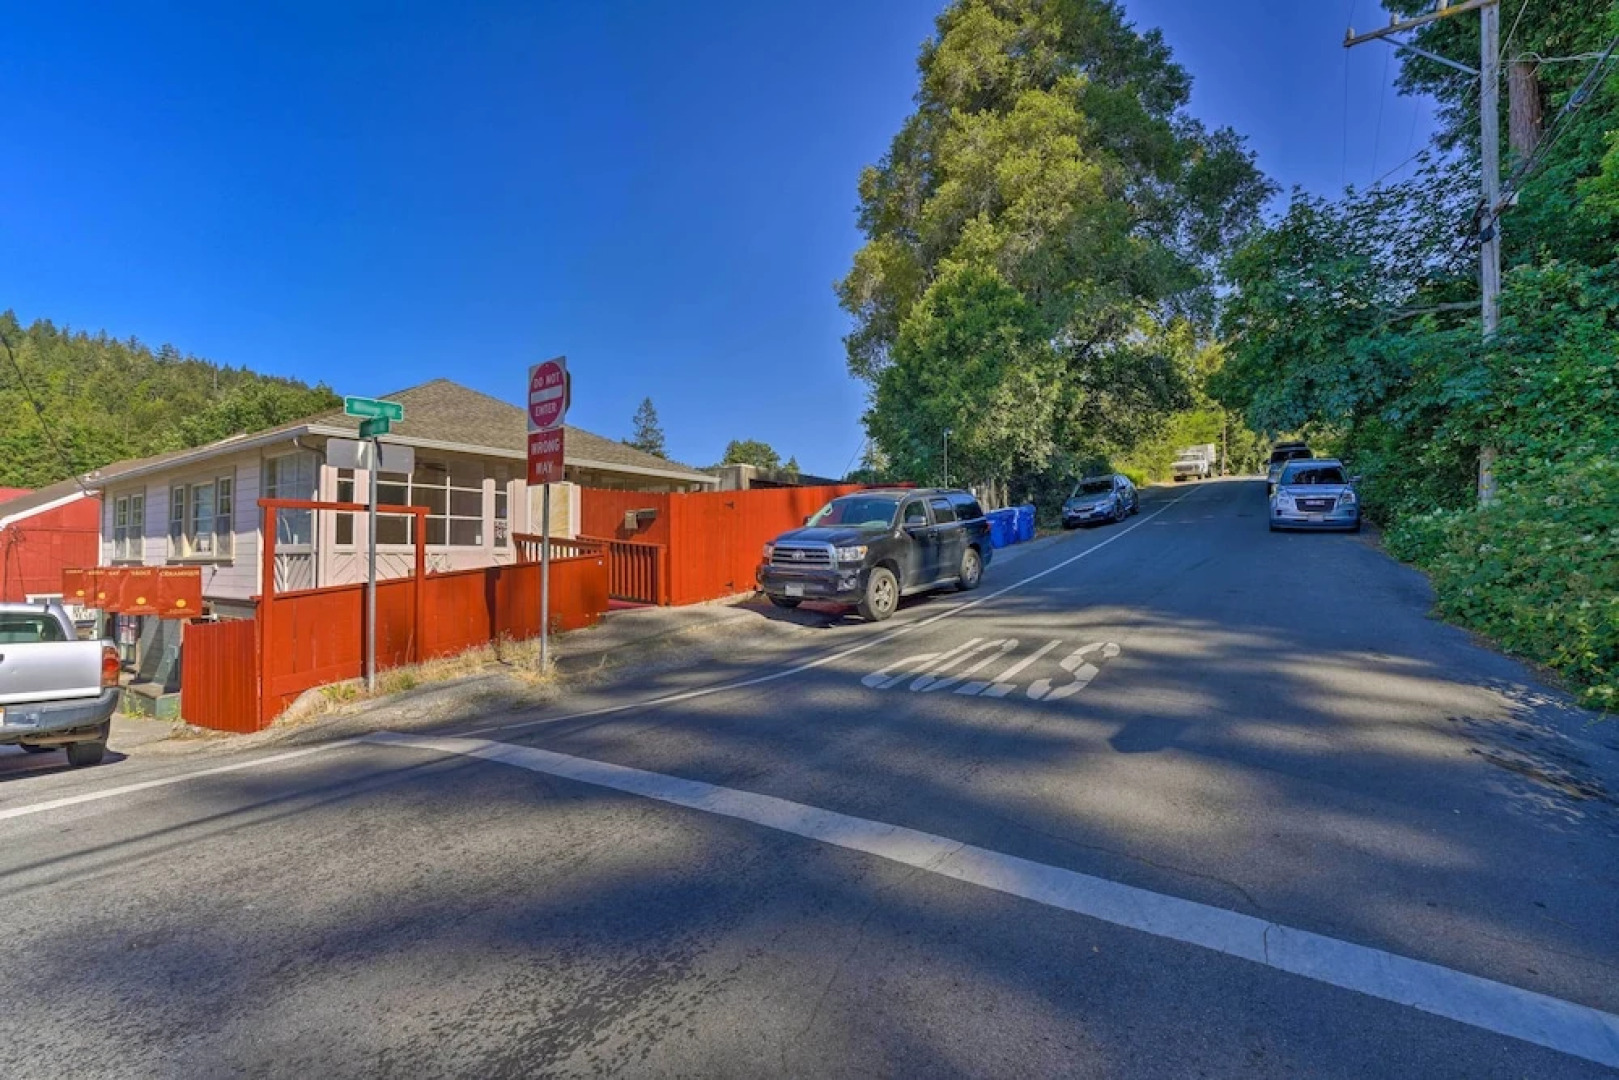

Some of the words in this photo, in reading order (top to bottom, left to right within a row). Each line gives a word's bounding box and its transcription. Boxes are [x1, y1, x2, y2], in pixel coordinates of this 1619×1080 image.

[534, 377, 545, 389] DO
[546, 371, 561, 385] NOT
[535, 403, 557, 417] ENTER
[531, 439, 560, 455] WRONG
[535, 461, 554, 475] WAY
[860, 637, 1121, 702] STOP
